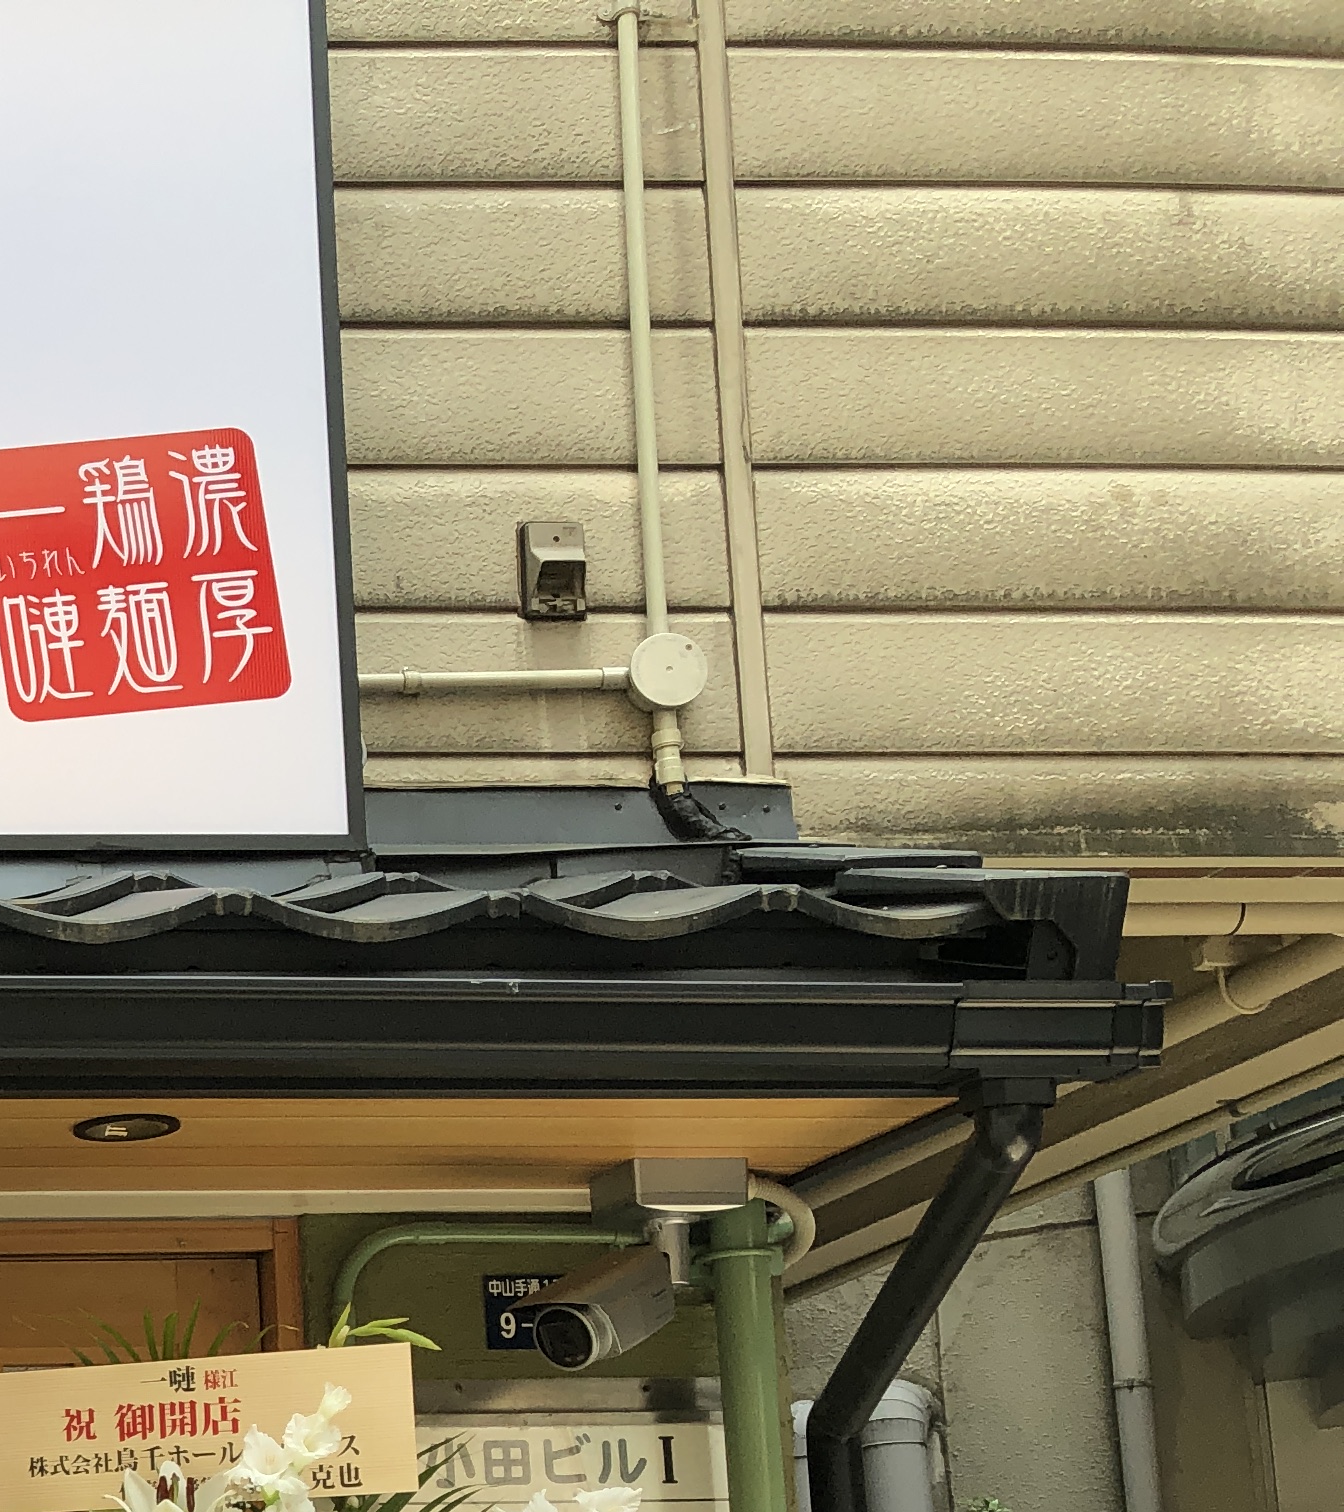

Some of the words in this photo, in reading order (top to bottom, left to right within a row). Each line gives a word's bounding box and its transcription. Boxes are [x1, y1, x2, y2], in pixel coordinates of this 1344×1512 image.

[168, 444, 273, 683] 濃厚
[488, 1278, 559, 1297] 中山手通
[203, 1369, 239, 1391] 様江
[62, 1408, 98, 1442] 祝
[114, 1396, 242, 1442] 御開店
[310, 1462, 364, 1491] 克也
